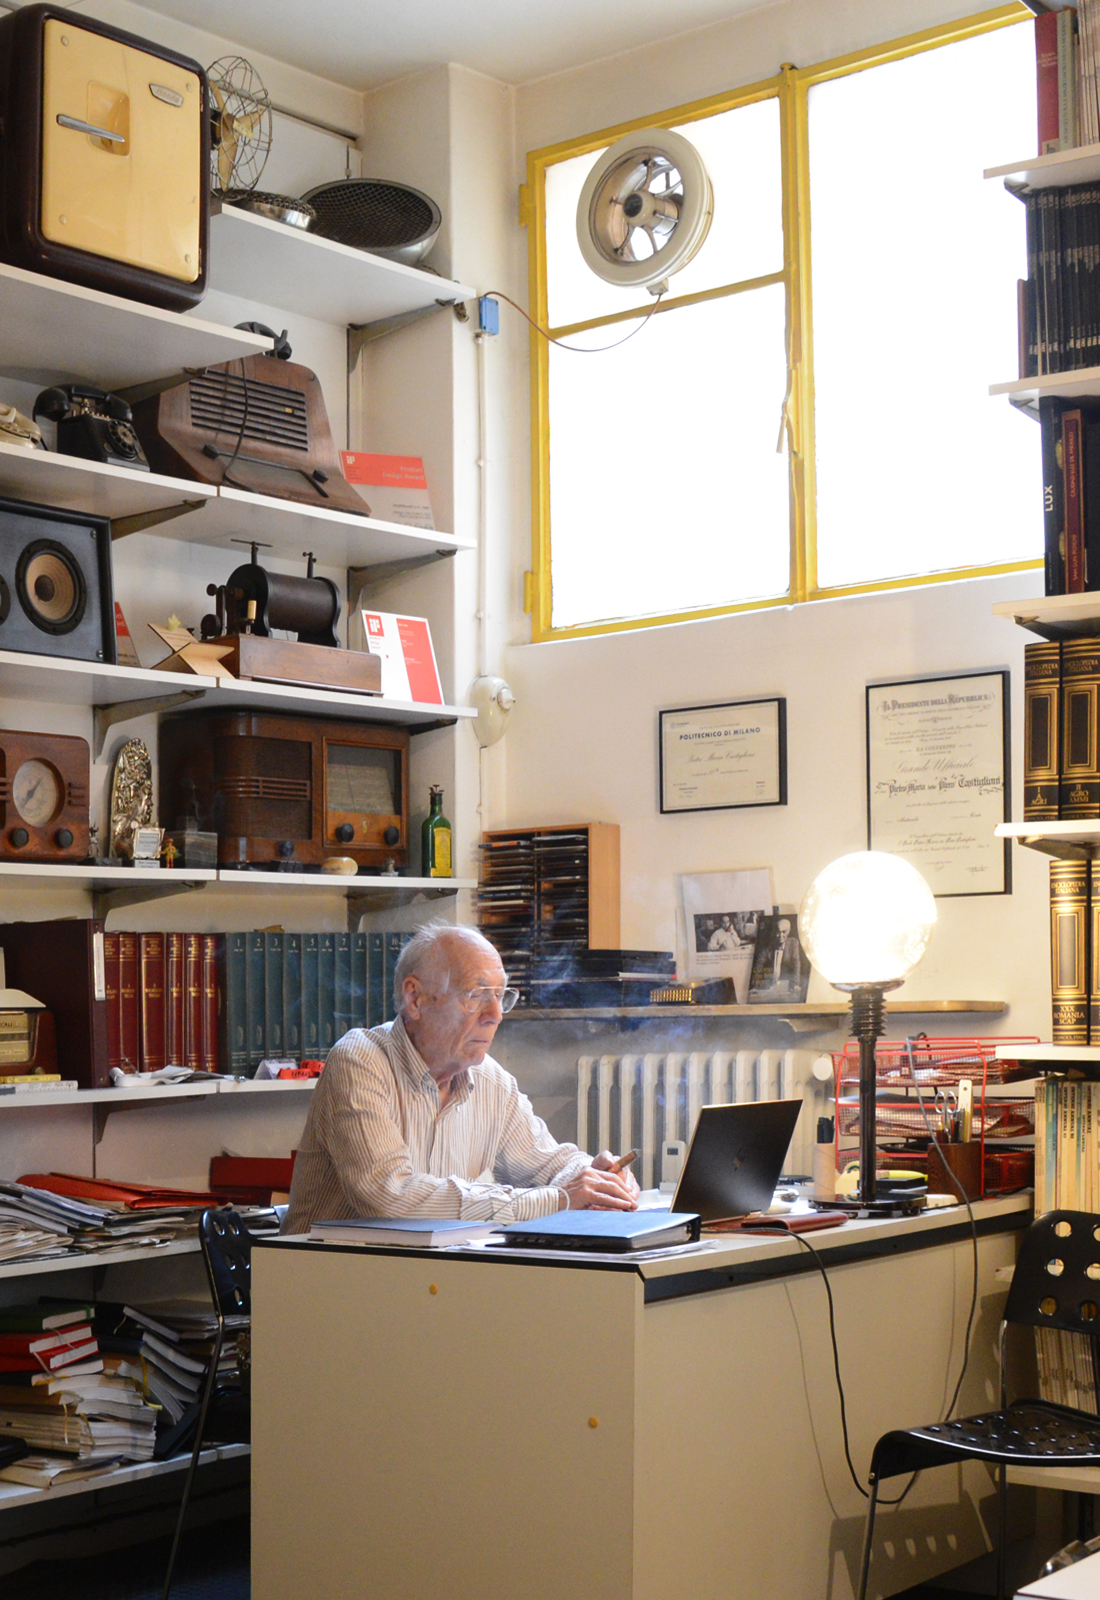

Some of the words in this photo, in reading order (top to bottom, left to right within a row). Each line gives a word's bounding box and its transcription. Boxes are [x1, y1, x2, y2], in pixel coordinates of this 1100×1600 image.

[382, 471, 403, 479] Design
[1044, 484, 1054, 512] LUX
[679, 731, 722, 740] POLITECNICO
[733, 727, 761, 735] MILANO
[1051, 881, 1086, 889] ENCICLOPEDIA
